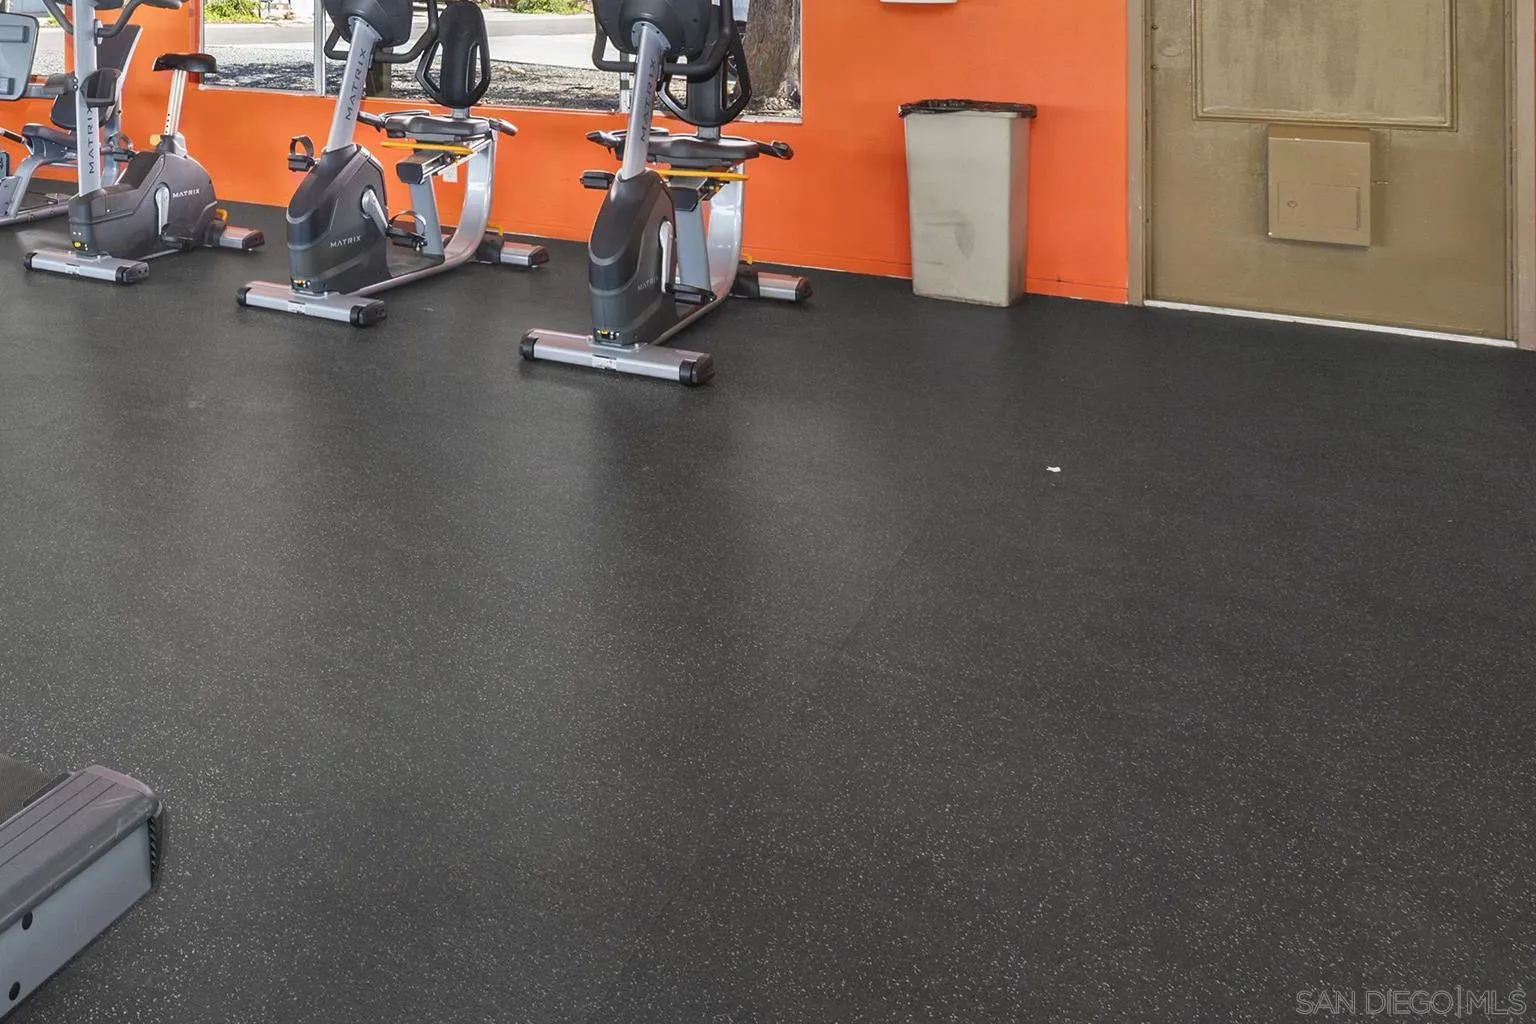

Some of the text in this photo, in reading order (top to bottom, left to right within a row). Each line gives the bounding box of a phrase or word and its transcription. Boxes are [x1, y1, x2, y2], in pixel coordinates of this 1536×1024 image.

[346, 48, 368, 121] MATRIX
[640, 58, 656, 142] MATRIX
[87, 108, 95, 174] MATRIX
[172, 189, 200, 198] MATRIX
[330, 235, 361, 248] MATRIX
